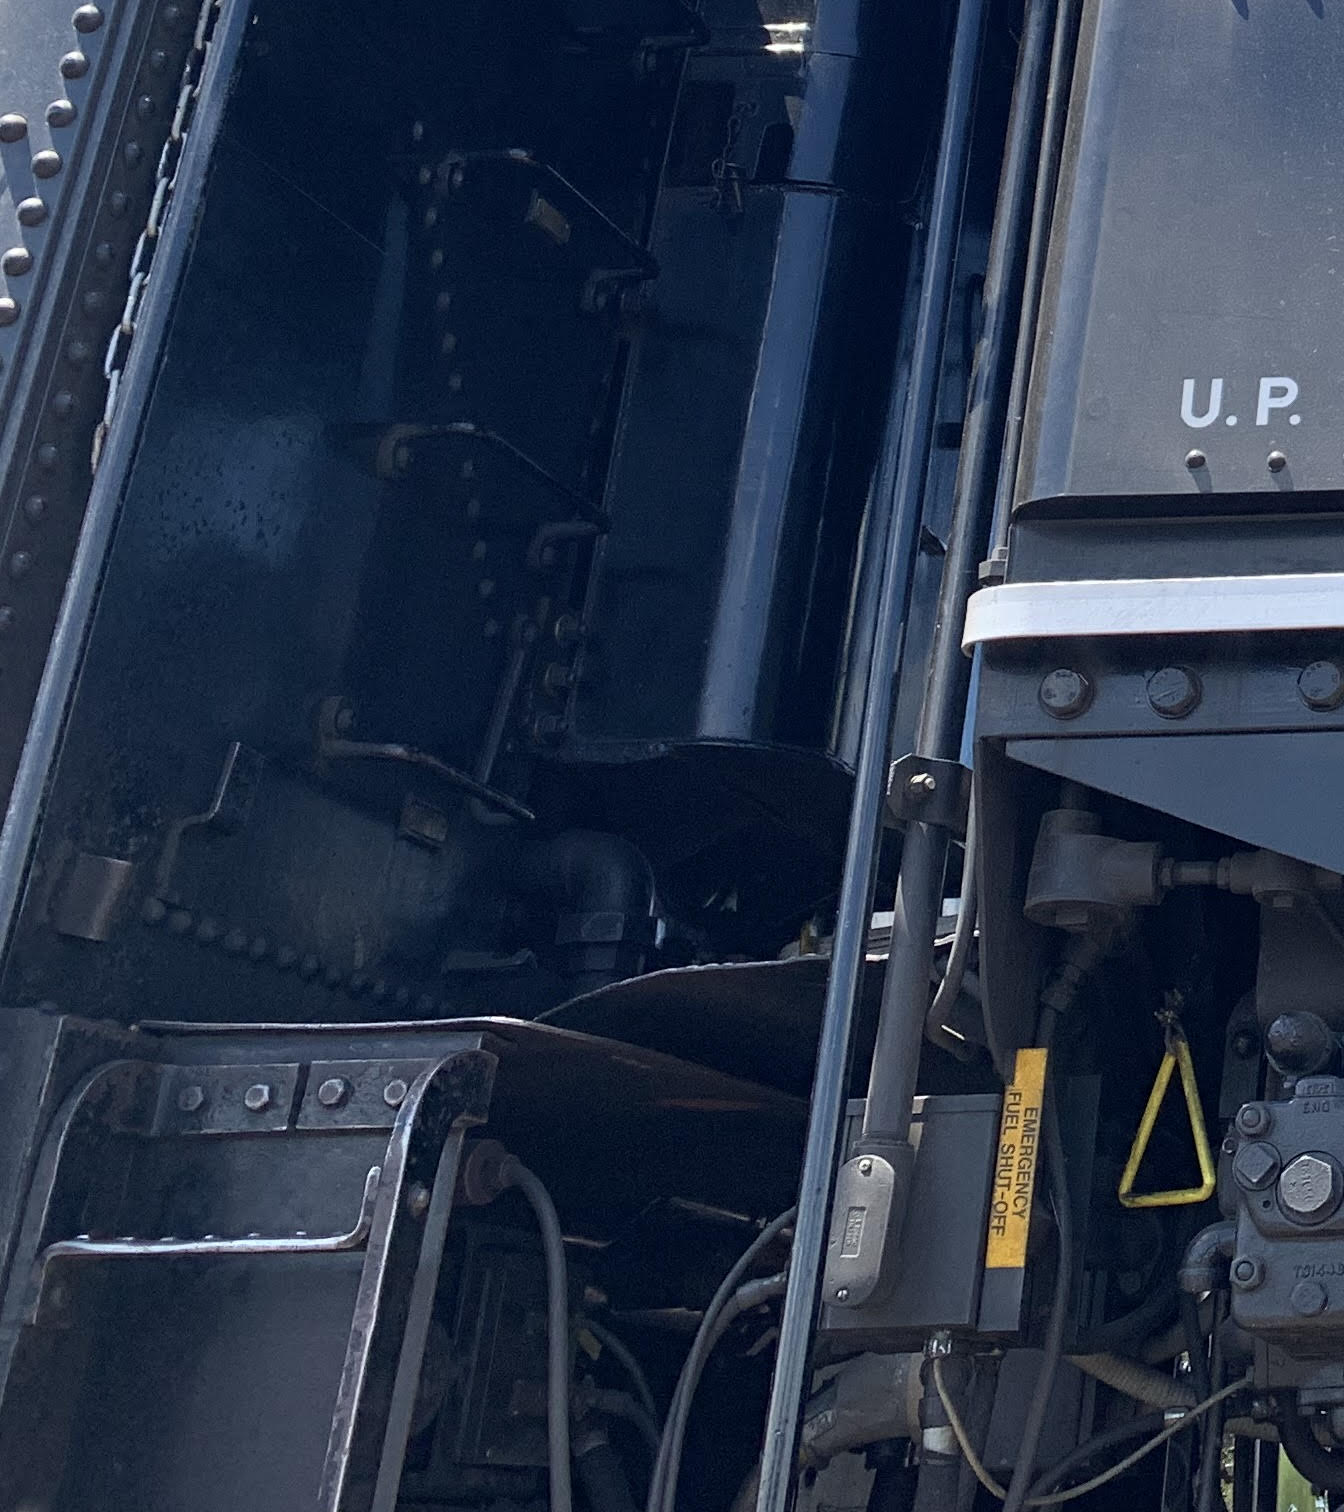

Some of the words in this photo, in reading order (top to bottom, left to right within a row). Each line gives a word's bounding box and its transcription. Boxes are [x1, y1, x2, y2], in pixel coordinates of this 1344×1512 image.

[1002, 1091, 1023, 1136] FUEL
[990, 1142, 1016, 1237] SHUT-OFF
[1012, 1106, 1039, 1220] EMERGENCY
